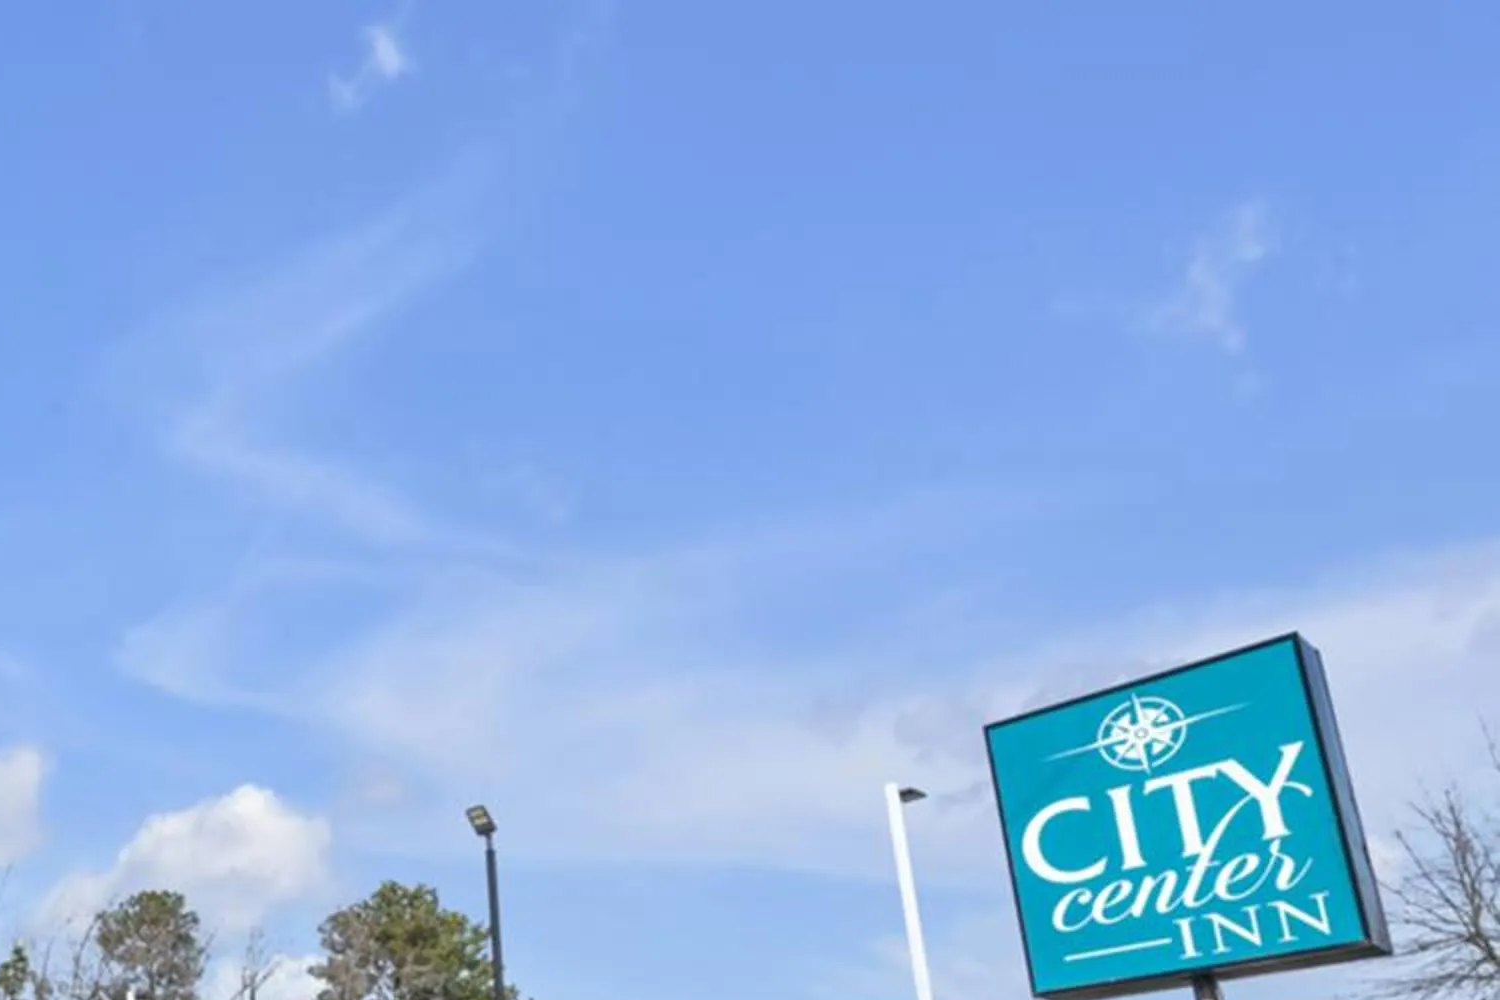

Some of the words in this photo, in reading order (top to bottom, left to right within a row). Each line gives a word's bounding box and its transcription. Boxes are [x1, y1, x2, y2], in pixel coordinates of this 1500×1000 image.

[1021, 741, 1305, 884] CITY
[1051, 784, 1314, 933] center
[1172, 891, 1331, 960] INN
